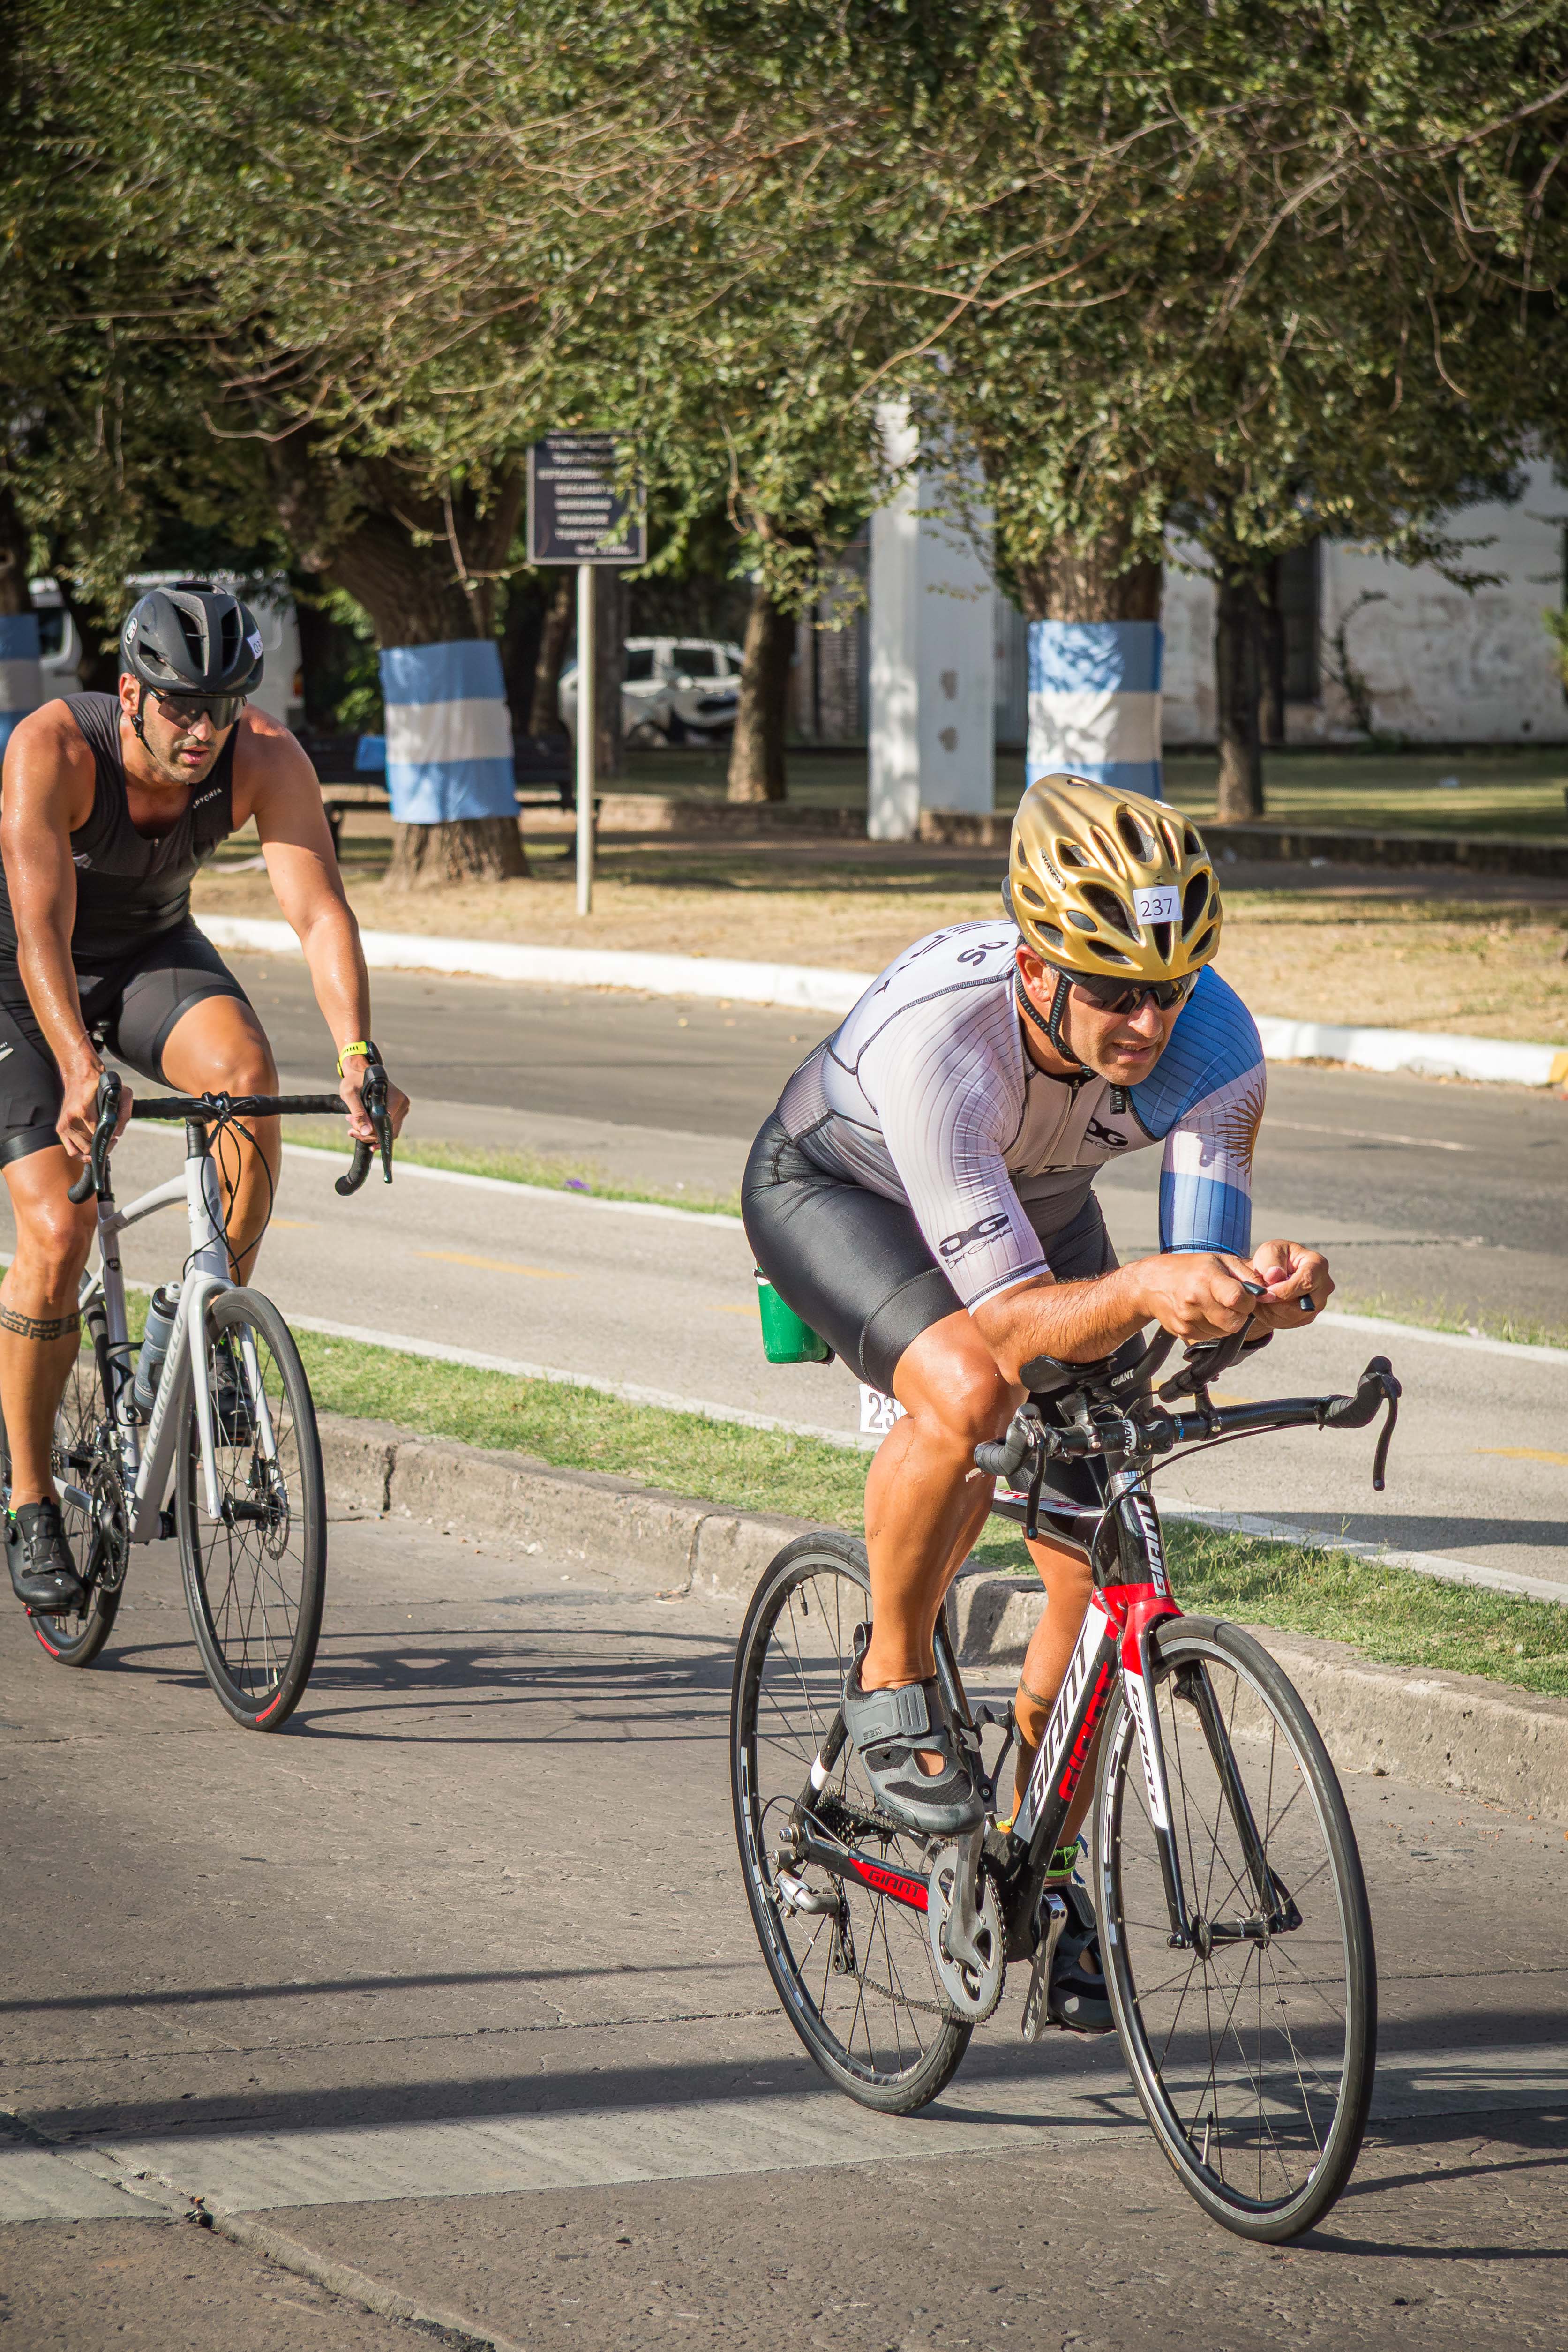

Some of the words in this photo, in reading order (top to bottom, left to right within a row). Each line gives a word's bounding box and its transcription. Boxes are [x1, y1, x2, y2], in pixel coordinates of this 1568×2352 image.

[1140, 898, 1172, 917] 237
[869, 1393, 897, 1430] 23
[1111, 1368, 1134, 1387] GIANT
[1133, 1496, 1167, 1596] GIANT
[1031, 1621, 1088, 1827] GIANT
[1059, 1662, 1113, 1803] GIANT
[1131, 1684, 1159, 1814] GIANT
[868, 1870, 923, 1898] GIANT
